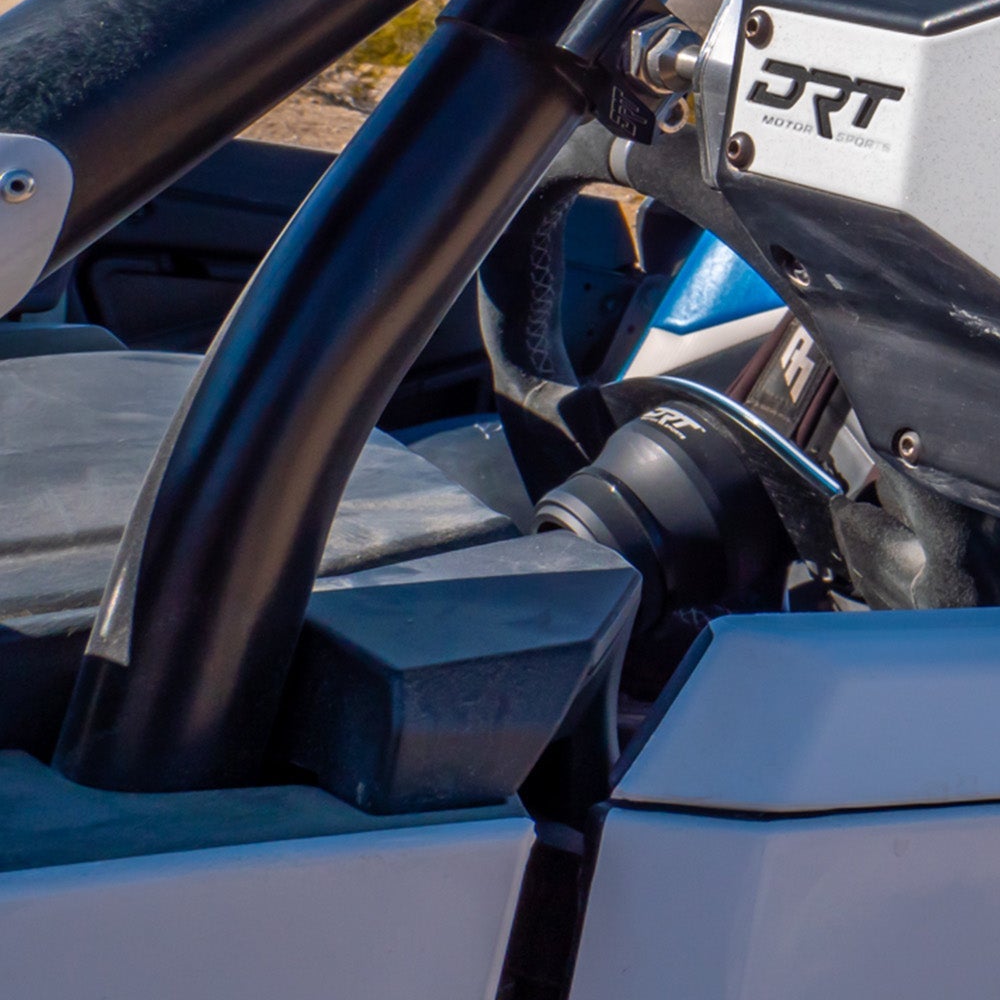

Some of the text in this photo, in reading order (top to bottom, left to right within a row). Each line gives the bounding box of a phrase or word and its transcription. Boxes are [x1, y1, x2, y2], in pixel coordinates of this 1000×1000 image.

[745, 57, 906, 140] DRT
[760, 114, 892, 152] MOTOR SPORTS
